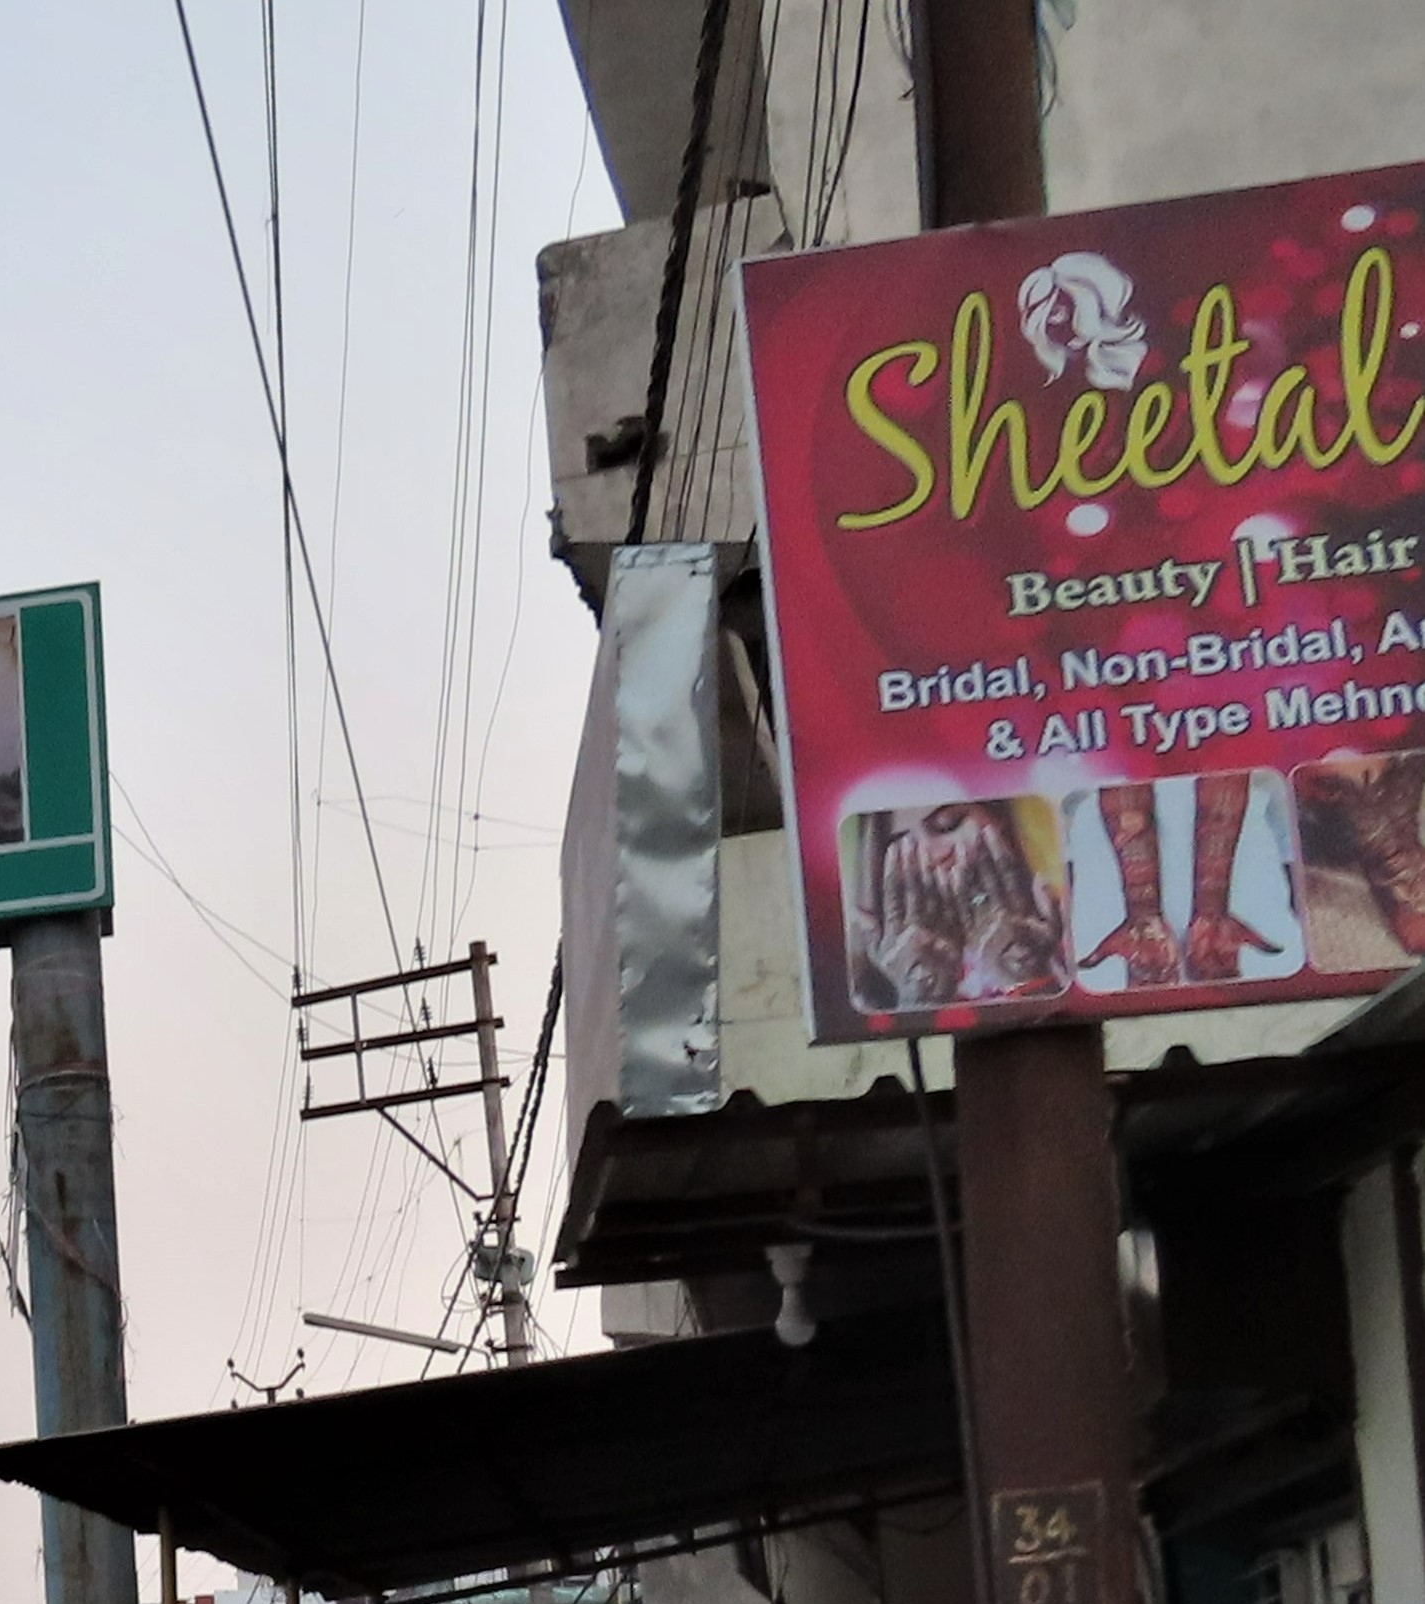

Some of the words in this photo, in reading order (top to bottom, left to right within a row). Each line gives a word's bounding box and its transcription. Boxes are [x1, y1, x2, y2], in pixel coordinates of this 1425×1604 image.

[836, 246, 1425, 530] Sheetal
[1006, 555, 1223, 617] Beauty
[1275, 530, 1420, 586] Hair
[878, 655, 1047, 712] Bridal,
[1061, 617, 1364, 690] Non-Bridal,
[986, 719, 1023, 760] &
[1039, 709, 1106, 756] All
[1121, 694, 1250, 755] Type
